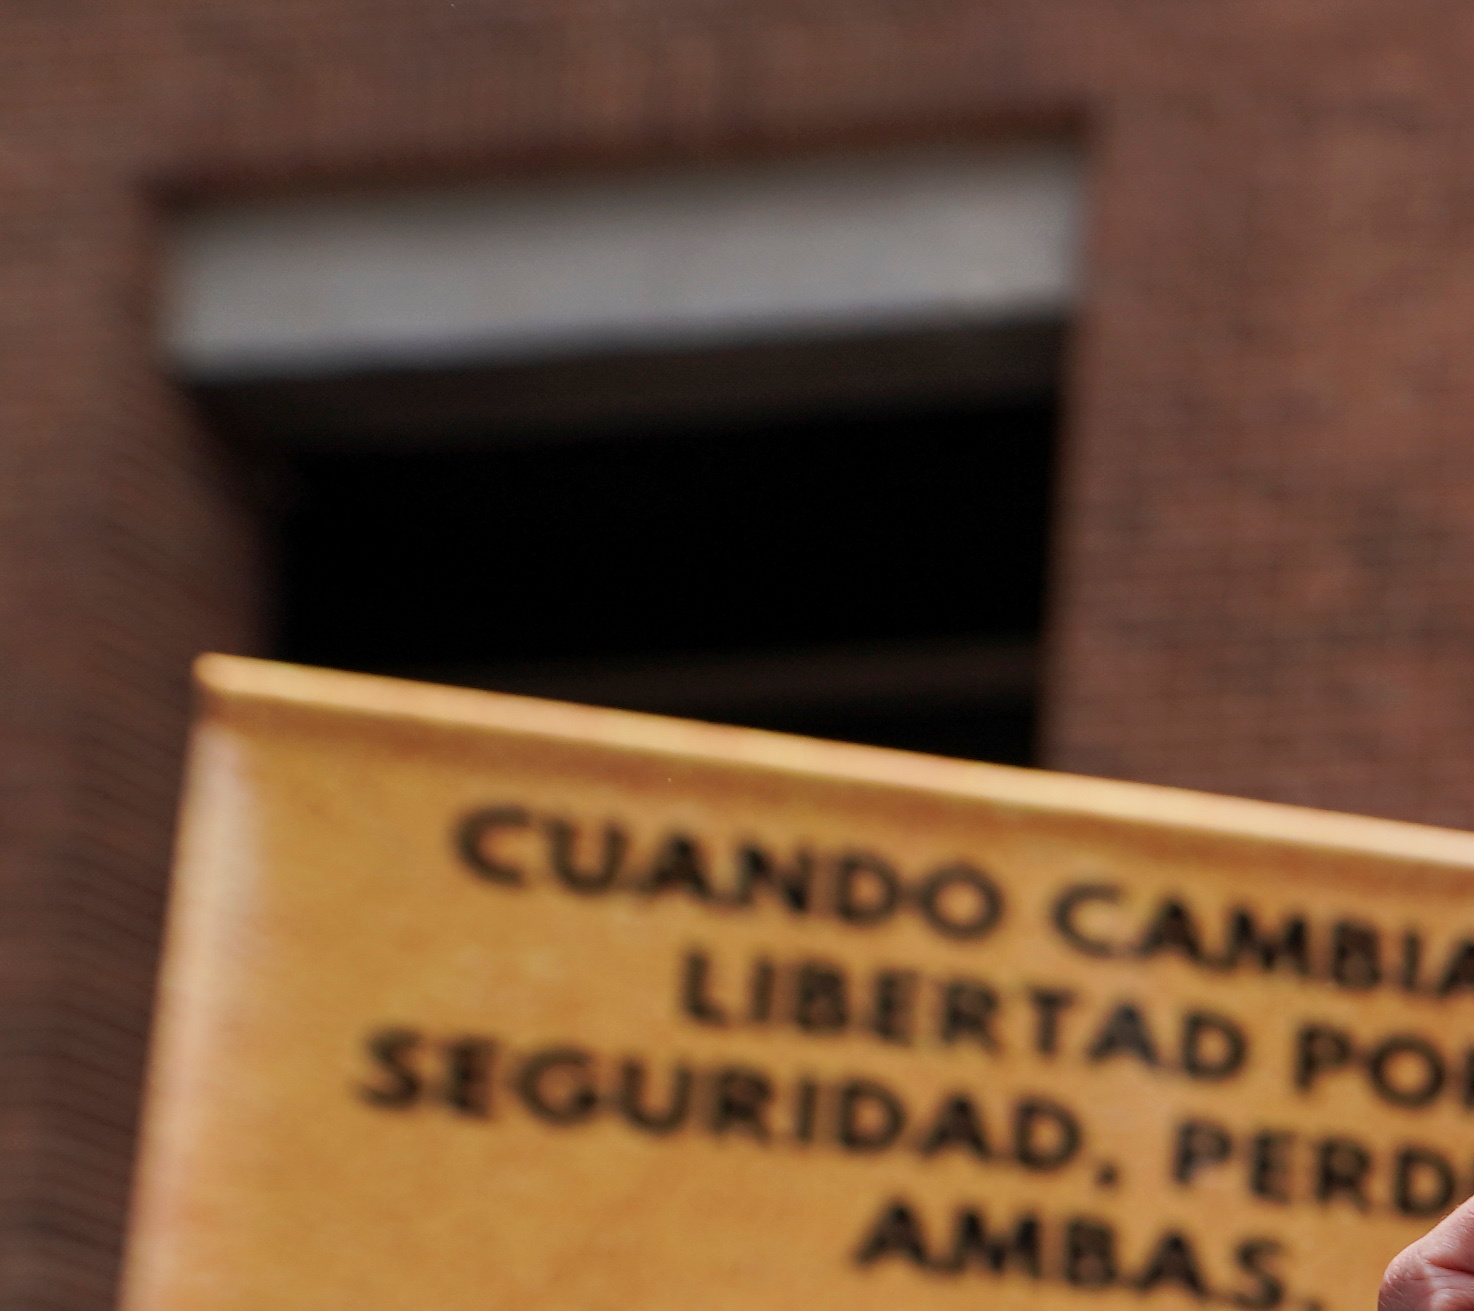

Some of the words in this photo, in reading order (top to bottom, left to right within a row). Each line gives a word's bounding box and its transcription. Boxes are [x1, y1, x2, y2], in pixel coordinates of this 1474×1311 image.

[453, 800, 1007, 942] CUANDO
[676, 942, 1250, 1082] LIBERTAD
[358, 1022, 1122, 1188] SEGURIDAD,
